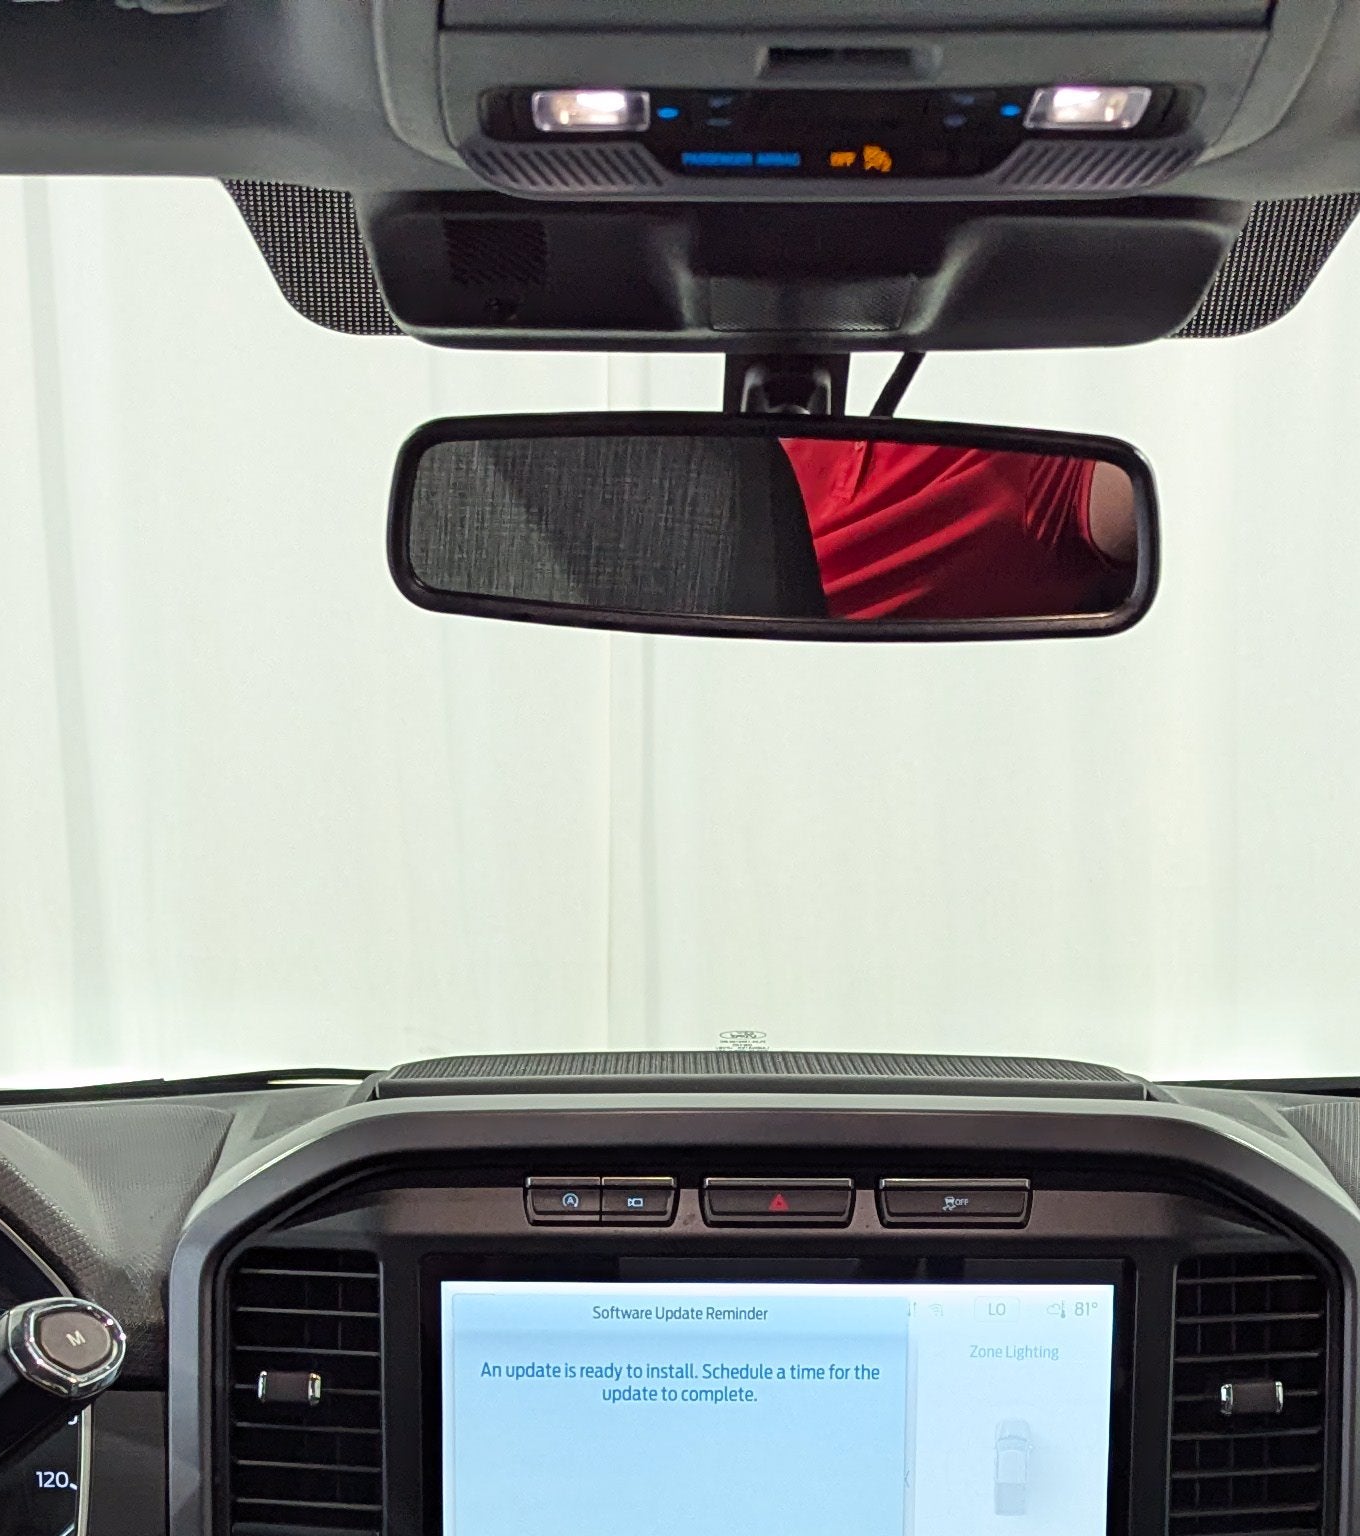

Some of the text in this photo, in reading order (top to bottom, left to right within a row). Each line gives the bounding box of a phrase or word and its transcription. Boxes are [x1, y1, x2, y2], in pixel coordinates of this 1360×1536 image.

[593, 1306, 768, 1322] Software Update Reminder
[989, 1303, 1006, 1315] LO
[1075, 1302, 1098, 1317] 81°
[65, 1331, 86, 1347] M
[969, 1345, 1060, 1361] Zone Lighting
[480, 1362, 880, 1381] An update is ready to install. Schedule a time for the
[602, 1385, 758, 1404] update to complete.
[36, 1471, 69, 1488] 120
